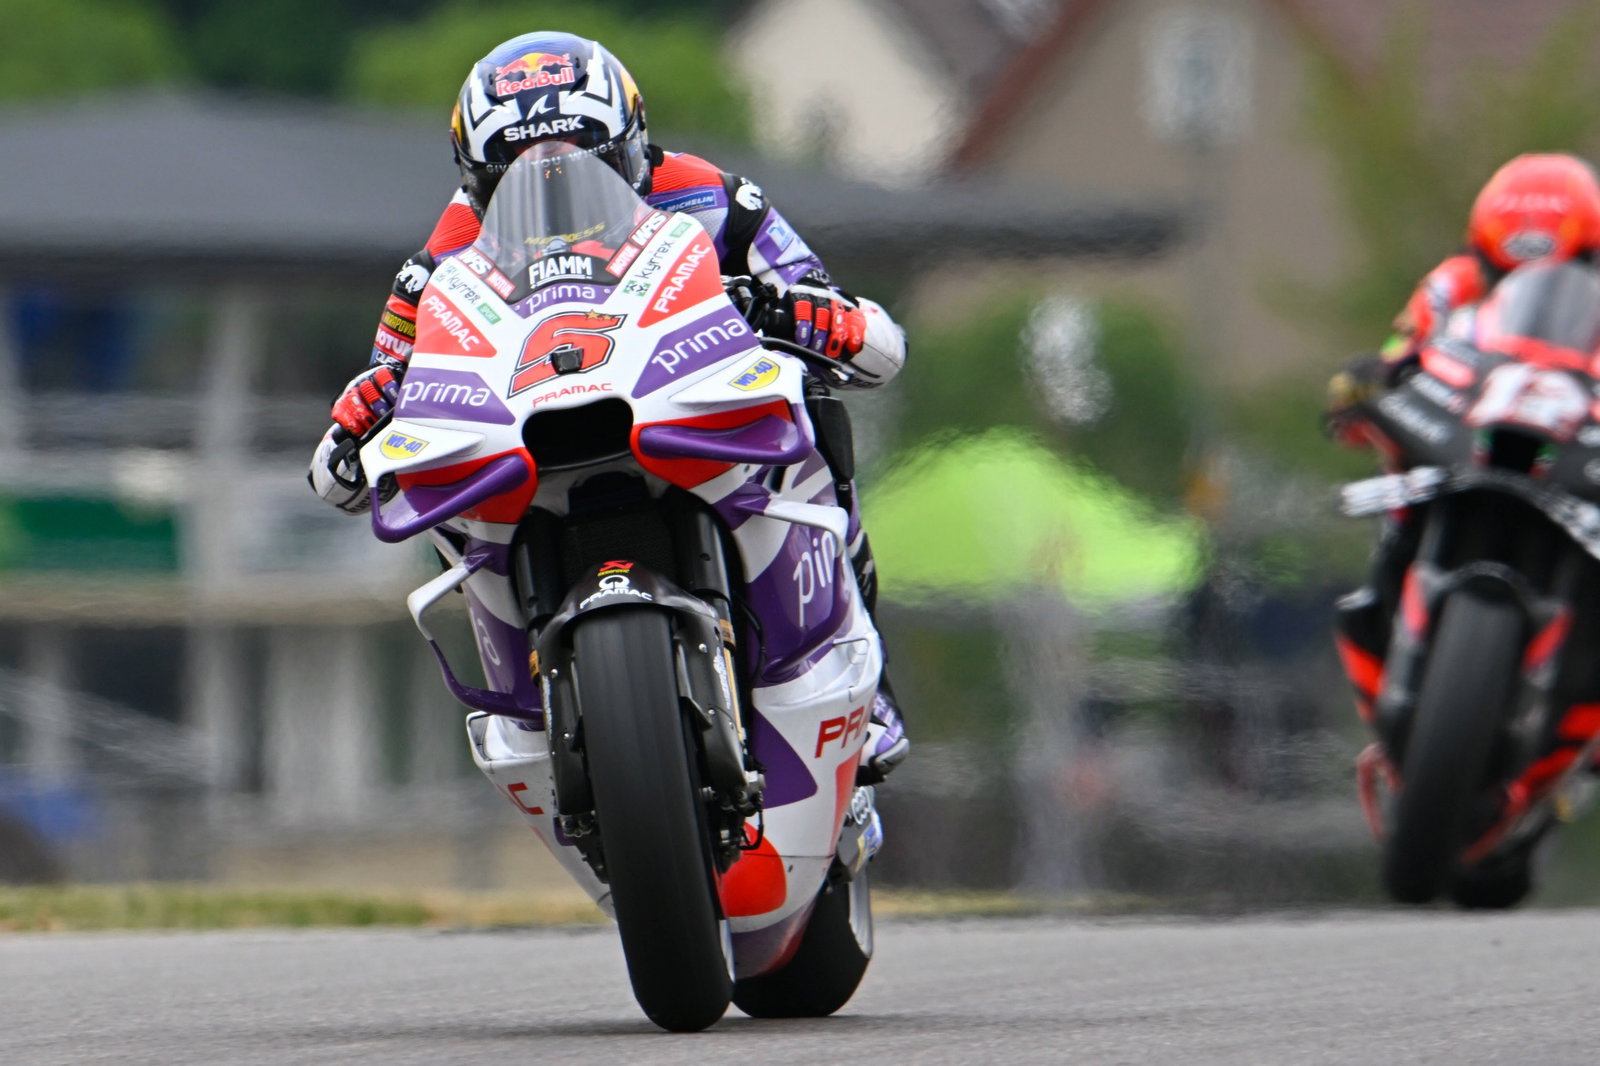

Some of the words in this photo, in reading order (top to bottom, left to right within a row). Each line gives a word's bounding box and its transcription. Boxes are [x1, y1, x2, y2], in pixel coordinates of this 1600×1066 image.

[496, 79, 536, 96] Red
[537, 67, 575, 88] Bull
[504, 116, 584, 141] SHARK
[632, 212, 668, 247] WRS
[458, 248, 494, 276] WRS
[528, 255, 593, 284] FIAMM
[653, 244, 712, 313] PRAMAC
[525, 284, 596, 315] prima
[421, 294, 480, 352] PRAMAC
[651, 317, 748, 374] prima
[733, 361, 774, 388] WD-40
[401, 380, 491, 409] prima
[532, 382, 613, 408] PRAMAC
[386, 433, 424, 454] WD-40
